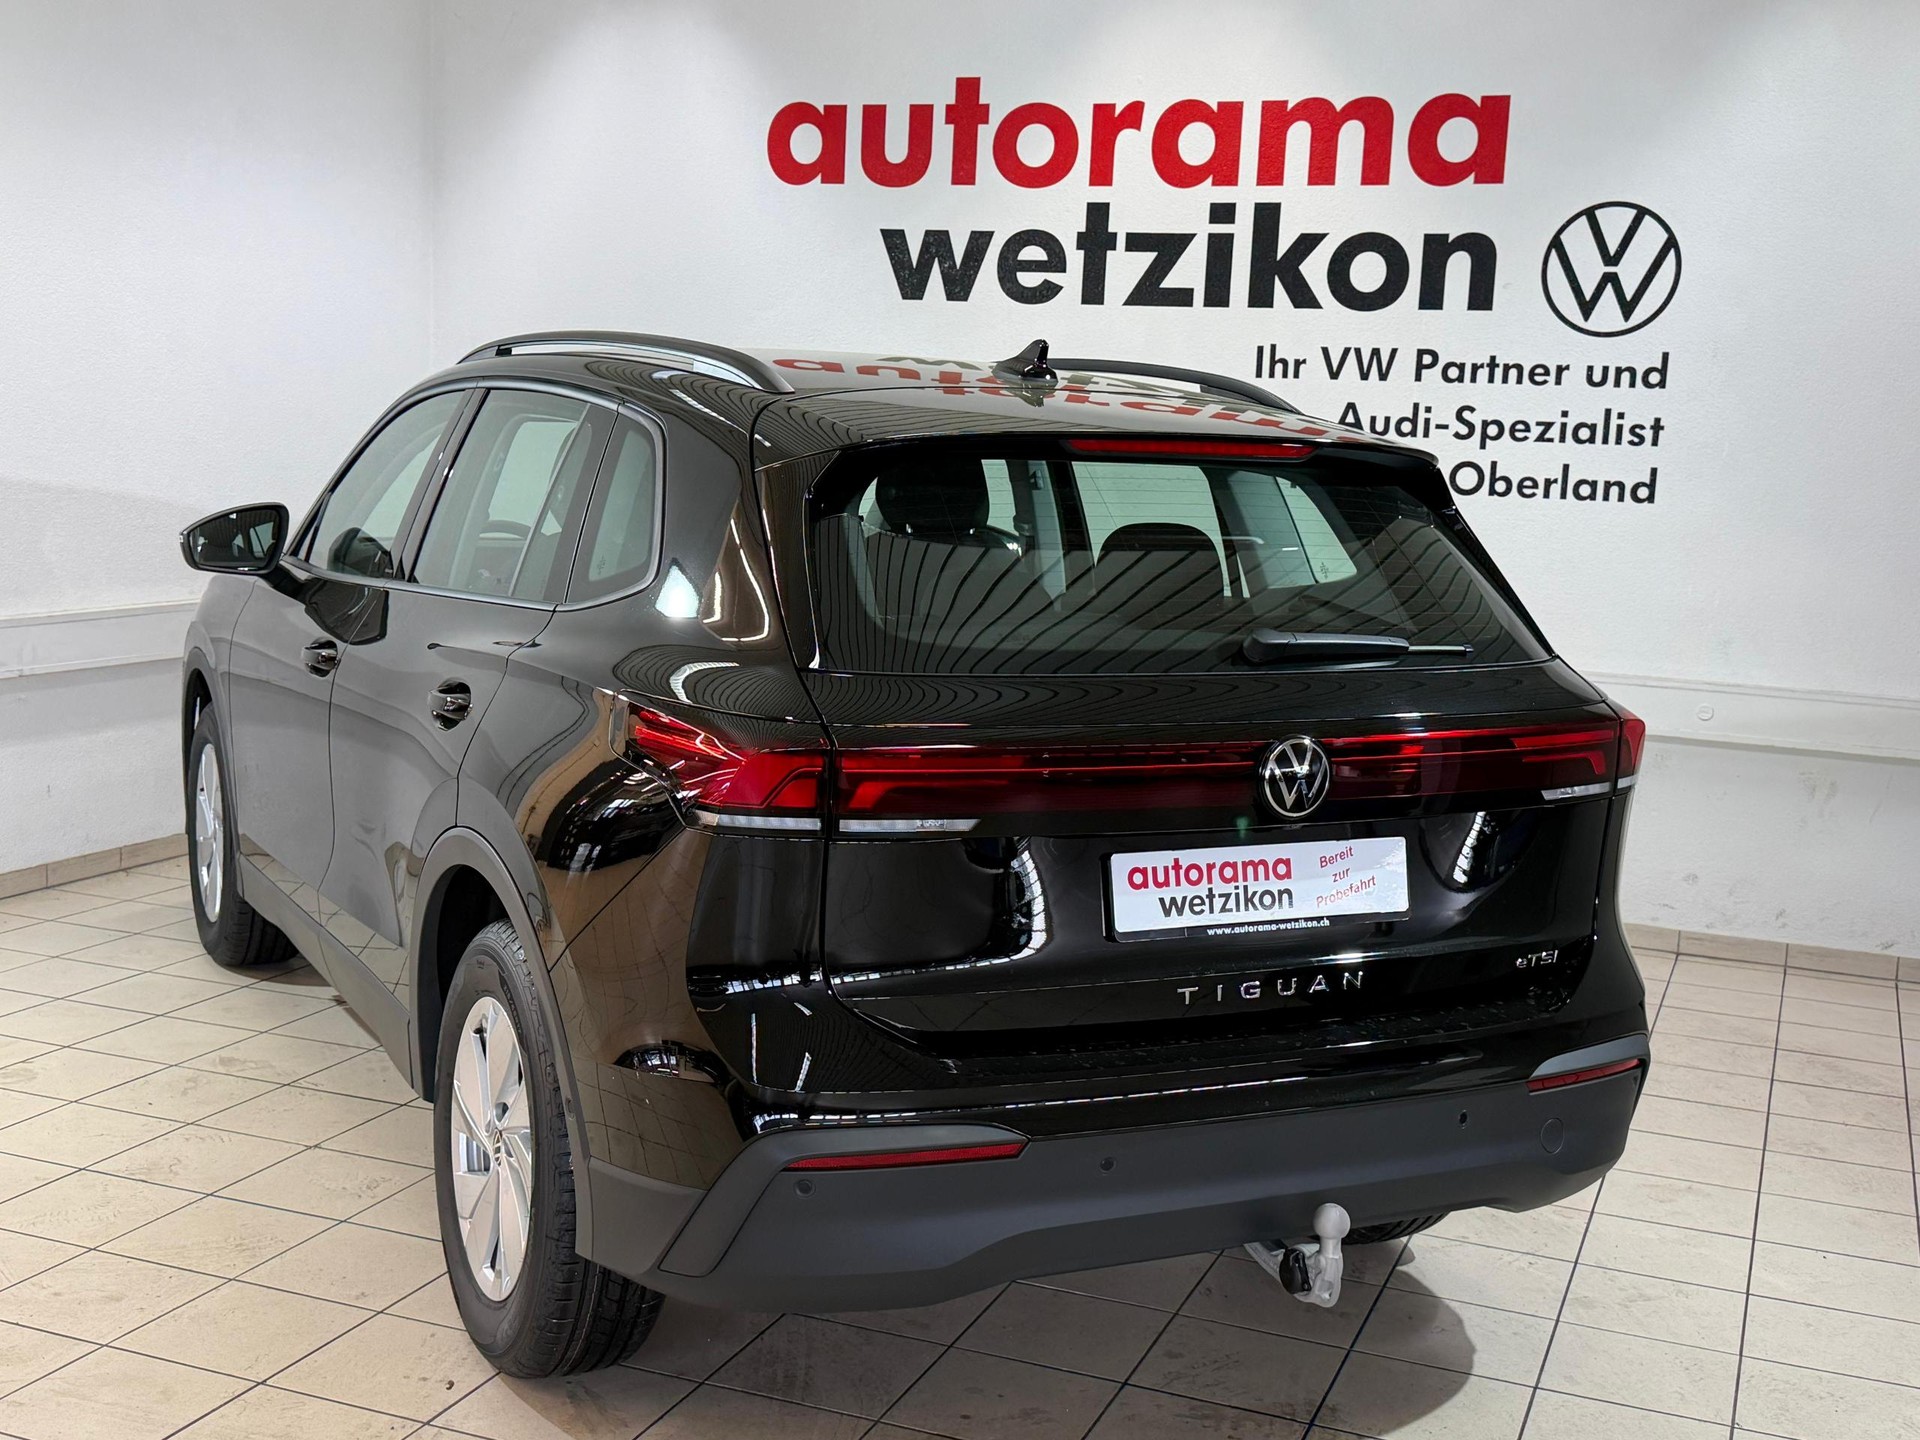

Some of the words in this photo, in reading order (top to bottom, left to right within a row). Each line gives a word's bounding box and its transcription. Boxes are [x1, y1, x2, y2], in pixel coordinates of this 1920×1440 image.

[768, 78, 1510, 189] autorama
[880, 203, 1496, 311] wetzikon
[1255, 344, 1307, 380] Ihr
[1321, 347, 1399, 382] VW
[1414, 348, 1570, 386] Partner
[1586, 352, 1670, 389] und
[1338, 402, 1665, 449] Audi-Spezialist
[1449, 461, 1658, 504] Oberland
[1319, 845, 1354, 868] Bereit
[1127, 857, 1293, 890] autorama
[1332, 867, 1351, 883] zur
[1158, 885, 1294, 918] wetzikon
[1315, 875, 1377, 908] Probefahrt
[1206, 917, 1330, 936] www.autorama-wetzikon.ch
[1515, 949, 1560, 969] eTSI
[1176, 970, 1365, 1006] TIGUAN
